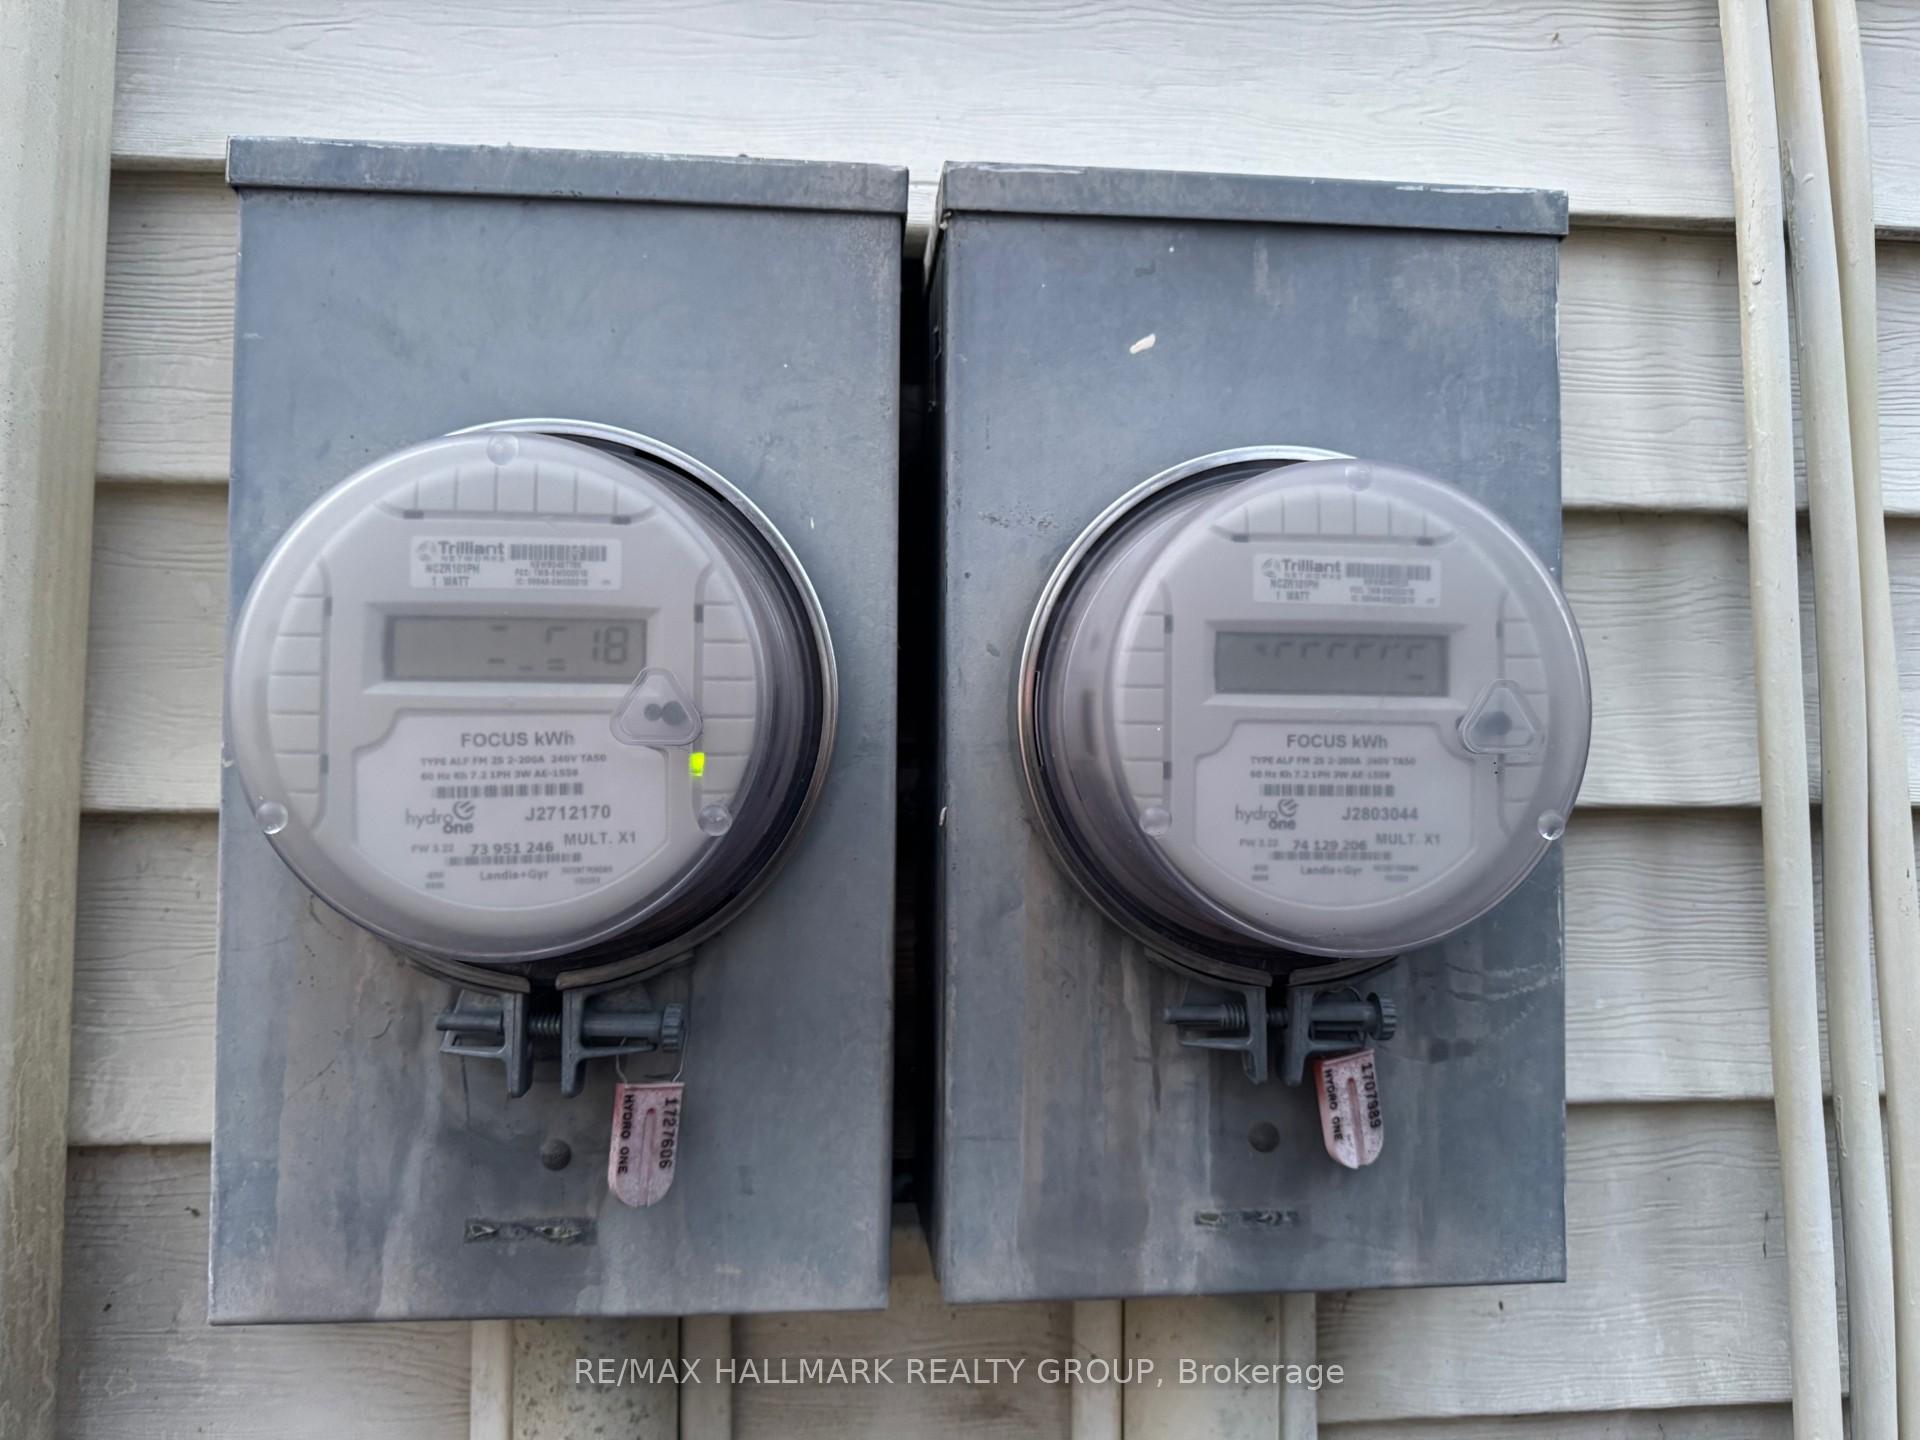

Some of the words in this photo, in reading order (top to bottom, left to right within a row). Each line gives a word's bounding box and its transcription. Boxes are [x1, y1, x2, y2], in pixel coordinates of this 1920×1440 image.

[438, 540, 505, 556] Trilliant
[1282, 558, 1341, 573] Trilliant
[443, 577, 470, 587] WATT
[460, 732, 529, 748] FOCUS
[534, 730, 574, 746] kWh
[1286, 734, 1347, 749] FOCUS
[1352, 734, 1387, 749] kWh
[421, 757, 446, 766] TYPE
[405, 808, 454, 830] hydro
[525, 804, 611, 822] J2712170
[1234, 804, 1278, 825] hydro
[1341, 806, 1418, 822] J2803044
[443, 820, 474, 835] one
[1268, 816, 1296, 831] one
[563, 832, 613, 847] MULT.
[618, 831, 636, 844] X1
[1424, 833, 1440, 846] X1
[471, 844, 488, 856] 73
[493, 843, 522, 855] 951
[526, 841, 554, 854] 246
[479, 868, 550, 883] Landis+Gyr
[1323, 1067, 1338, 1111] HYDRO
[1331, 1116, 1344, 1142] ONE
[620, 1093, 635, 1140] HYDRO
[658, 1096, 680, 1170] 1727606
[617, 1145, 630, 1175] ONE
